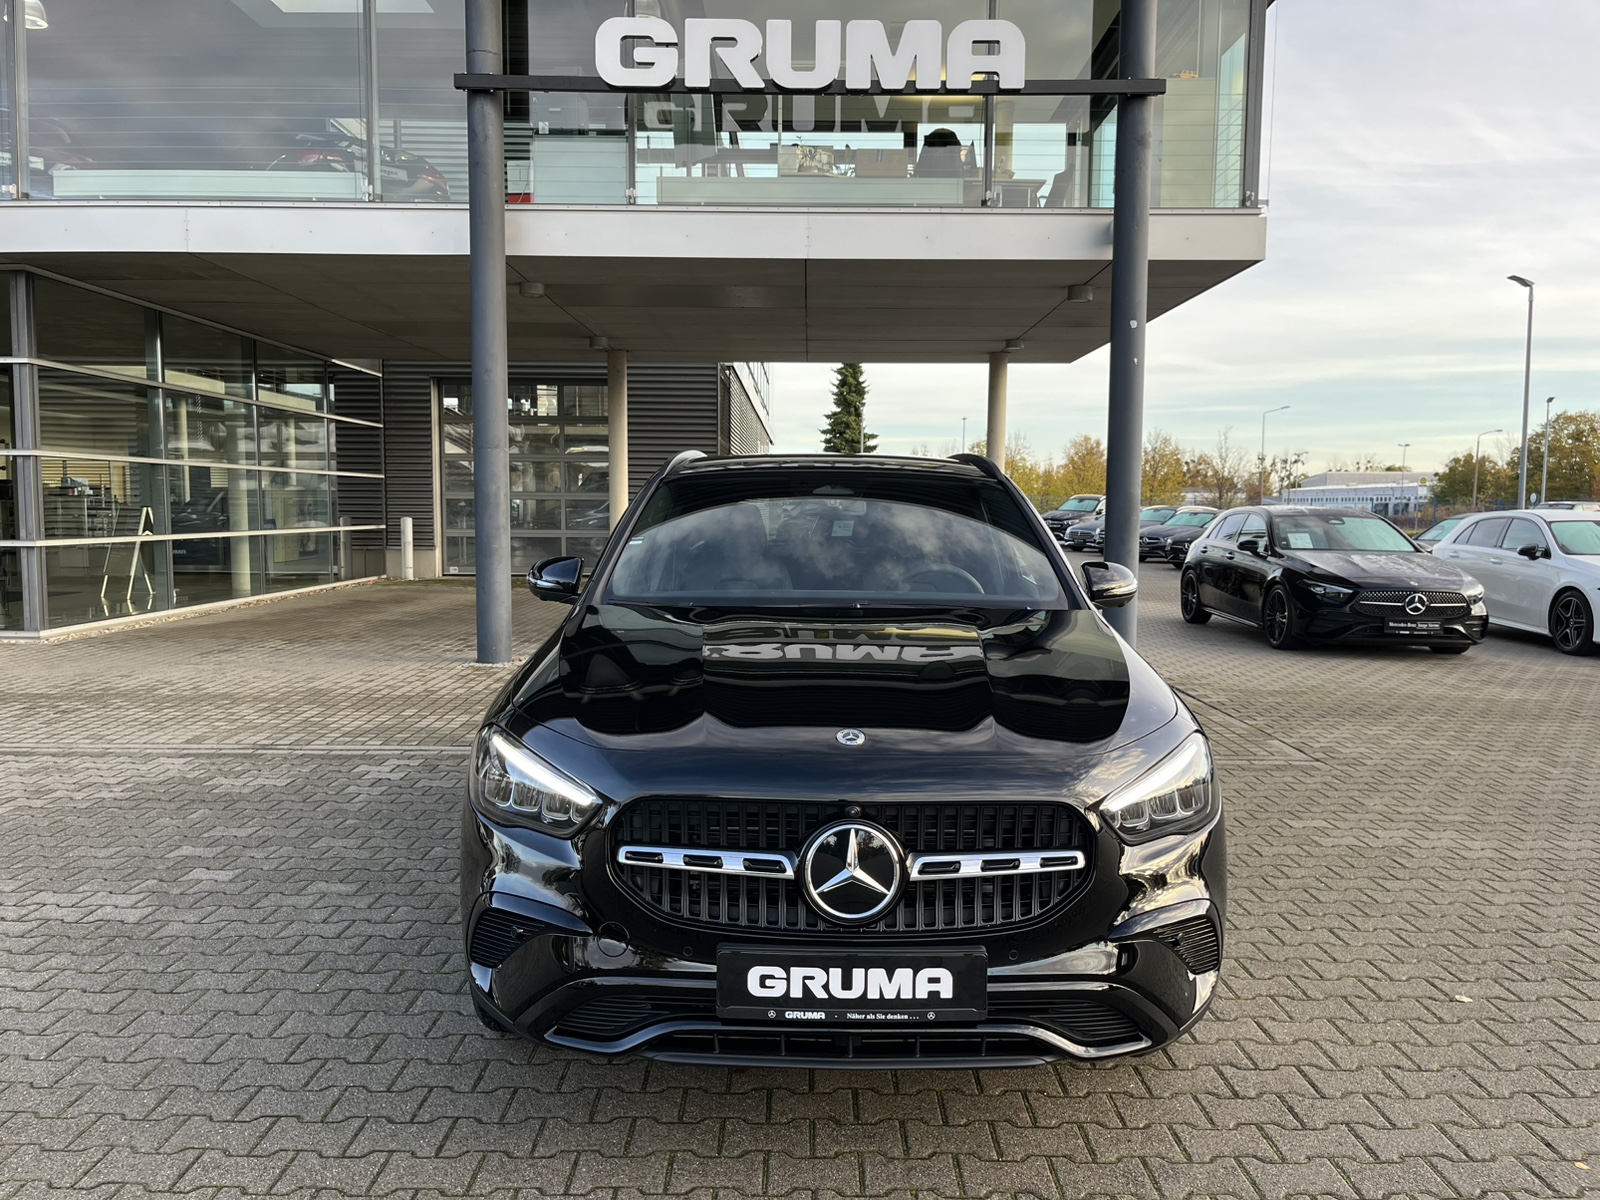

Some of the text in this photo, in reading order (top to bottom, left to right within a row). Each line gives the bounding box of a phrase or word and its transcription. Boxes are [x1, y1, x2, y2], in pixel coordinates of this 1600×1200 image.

[595, 16, 1026, 90] GRUMA
[747, 965, 953, 1000] GRUMA
[784, 1010, 826, 1020] GRUMA
[846, 1012, 866, 1020] Näher
